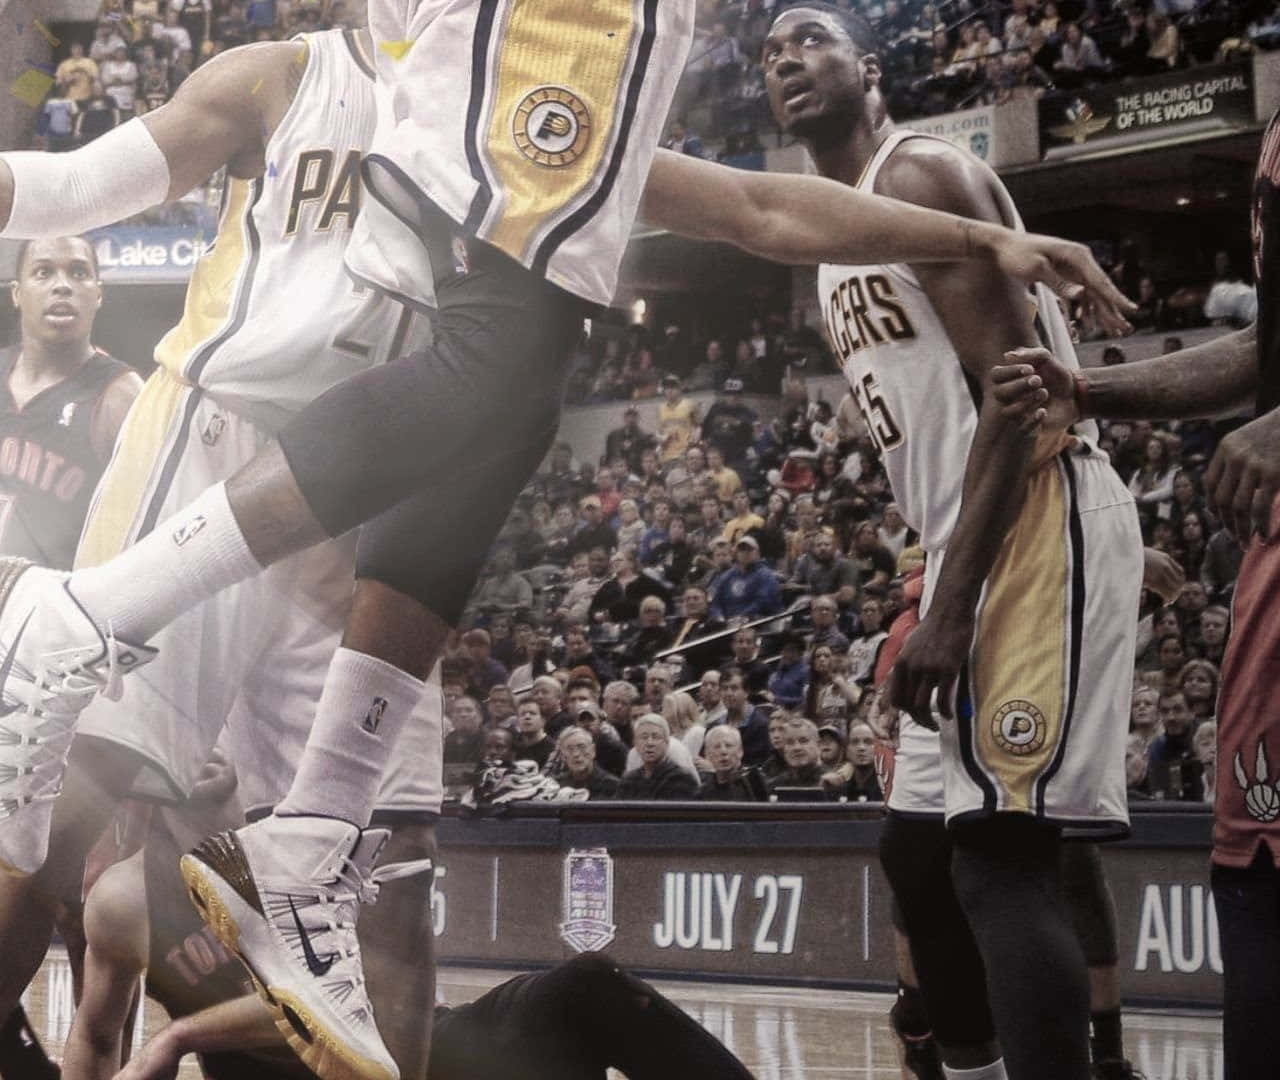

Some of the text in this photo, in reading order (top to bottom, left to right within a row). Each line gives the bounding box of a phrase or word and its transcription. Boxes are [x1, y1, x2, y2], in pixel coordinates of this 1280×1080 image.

[1116, 76, 1248, 112] THE RACING CAPITAL
[1117, 97, 1214, 130] OF THE WORLD
[99, 239, 168, 267] Lake
[826, 275, 917, 361] CERS
[653, 872, 743, 951] JULY
[754, 874, 804, 954] 27
